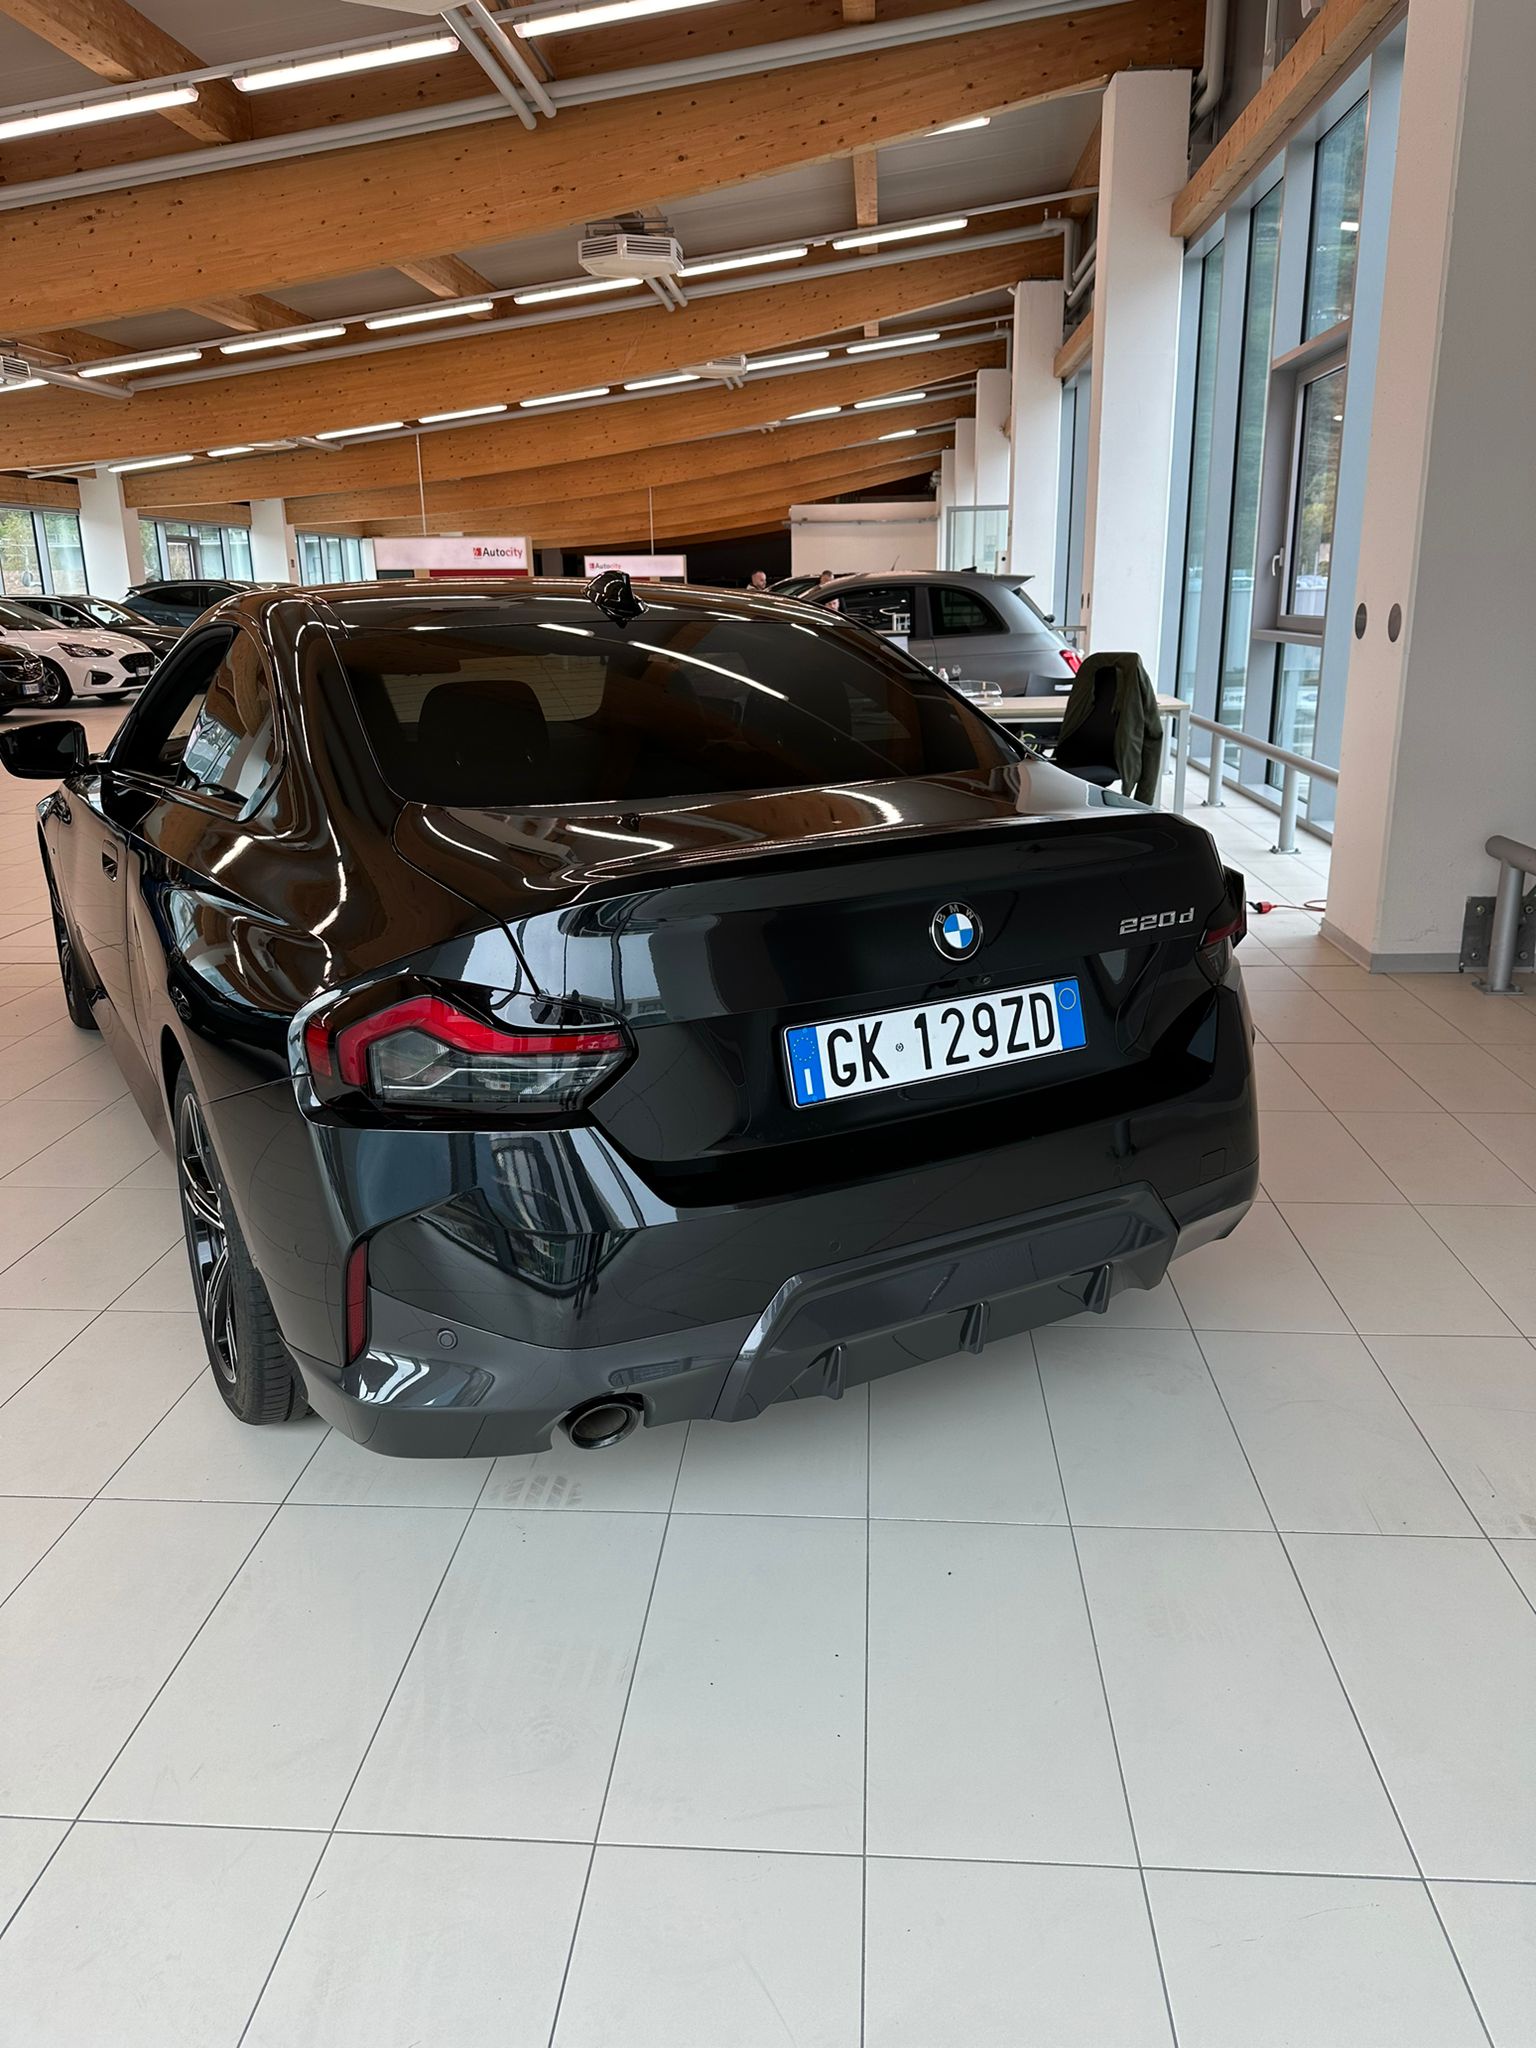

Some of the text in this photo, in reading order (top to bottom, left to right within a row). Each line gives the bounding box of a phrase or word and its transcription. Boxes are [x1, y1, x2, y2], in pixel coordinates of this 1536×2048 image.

[483, 547, 523, 559] Autocity
[936, 904, 974, 925] BMW
[1119, 907, 1195, 935] 220d
[827, 1021, 890, 1087] GK
[914, 992, 1055, 1070] 129ZD
